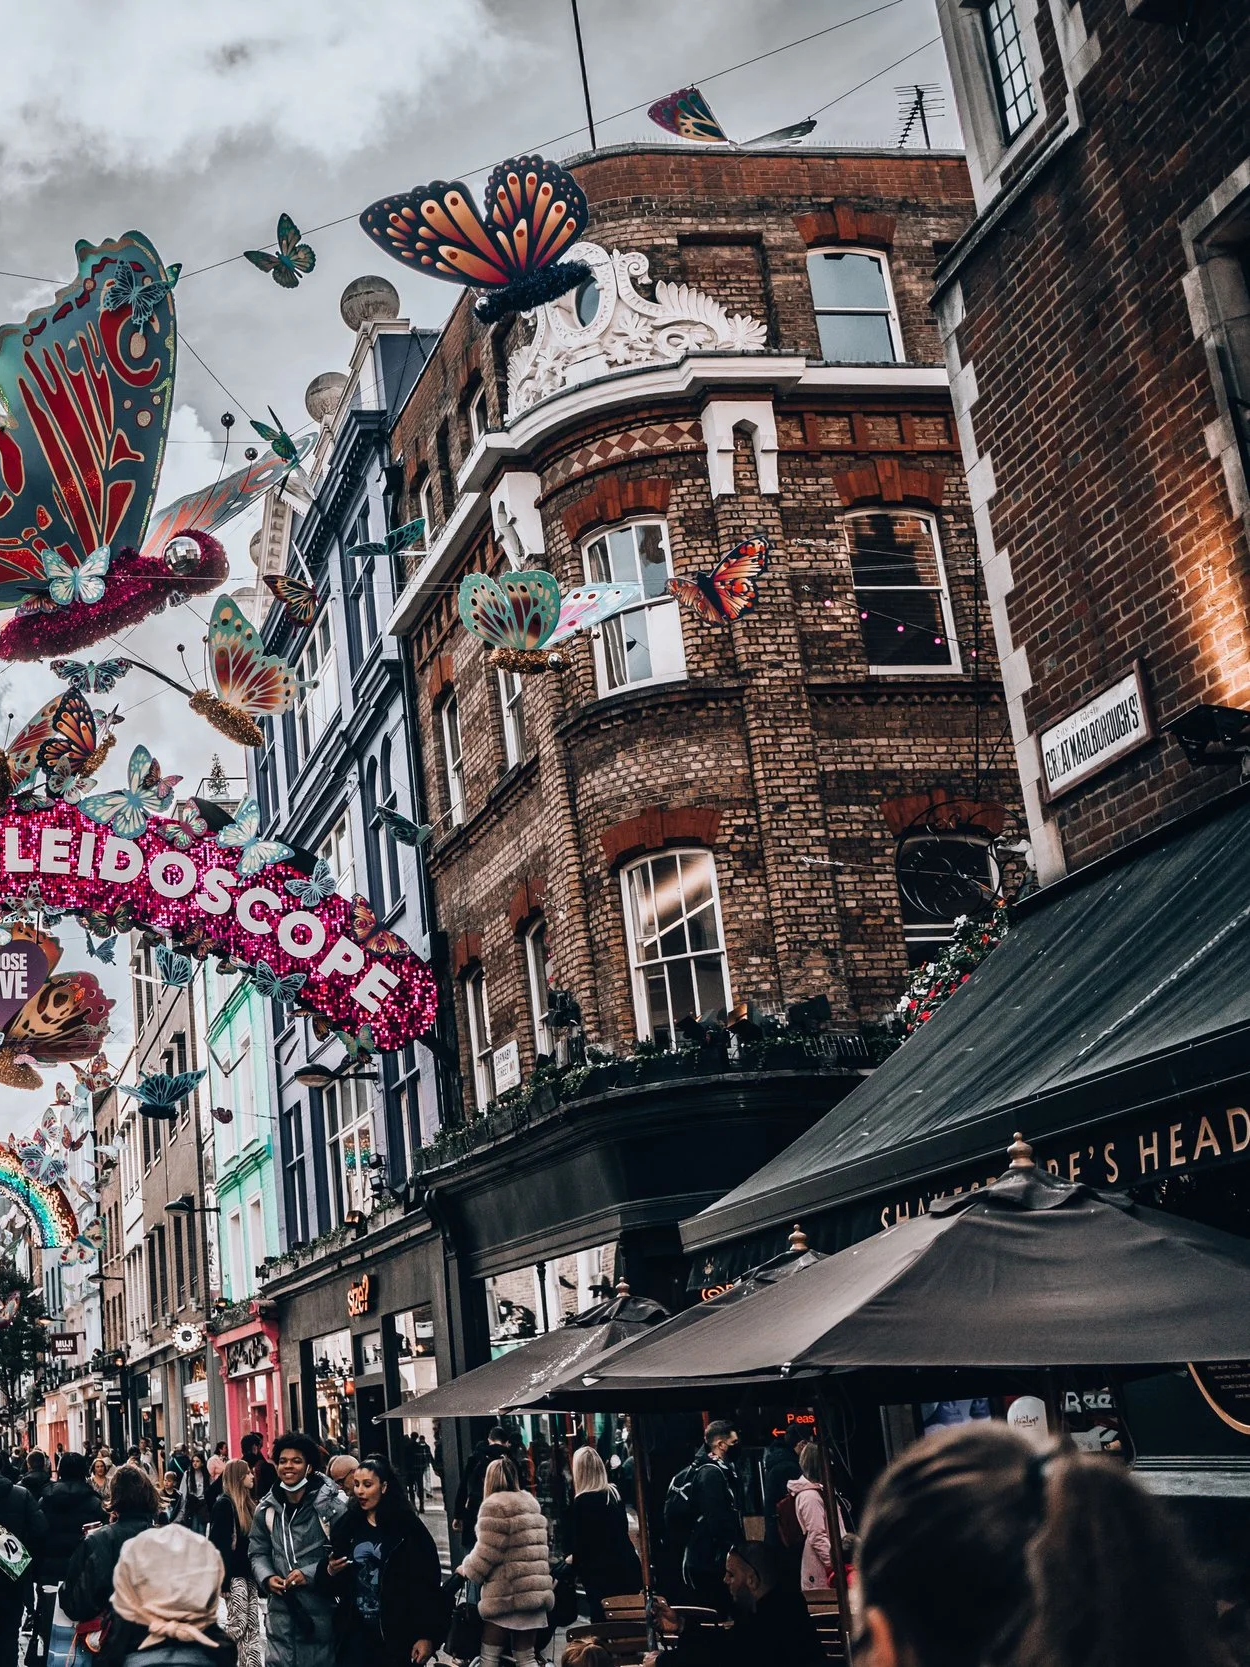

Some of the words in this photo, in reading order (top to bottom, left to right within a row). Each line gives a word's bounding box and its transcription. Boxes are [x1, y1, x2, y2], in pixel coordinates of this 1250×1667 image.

[1069, 699, 1133, 768] MARLBOROUGH
[1138, 1106, 1250, 1174] HEAD
[347, 1273, 369, 1317] size?
[55, 1339, 74, 1348] MUJI
[1065, 1391, 1114, 1413] Ree
[3, 1538, 19, 1560] JD
